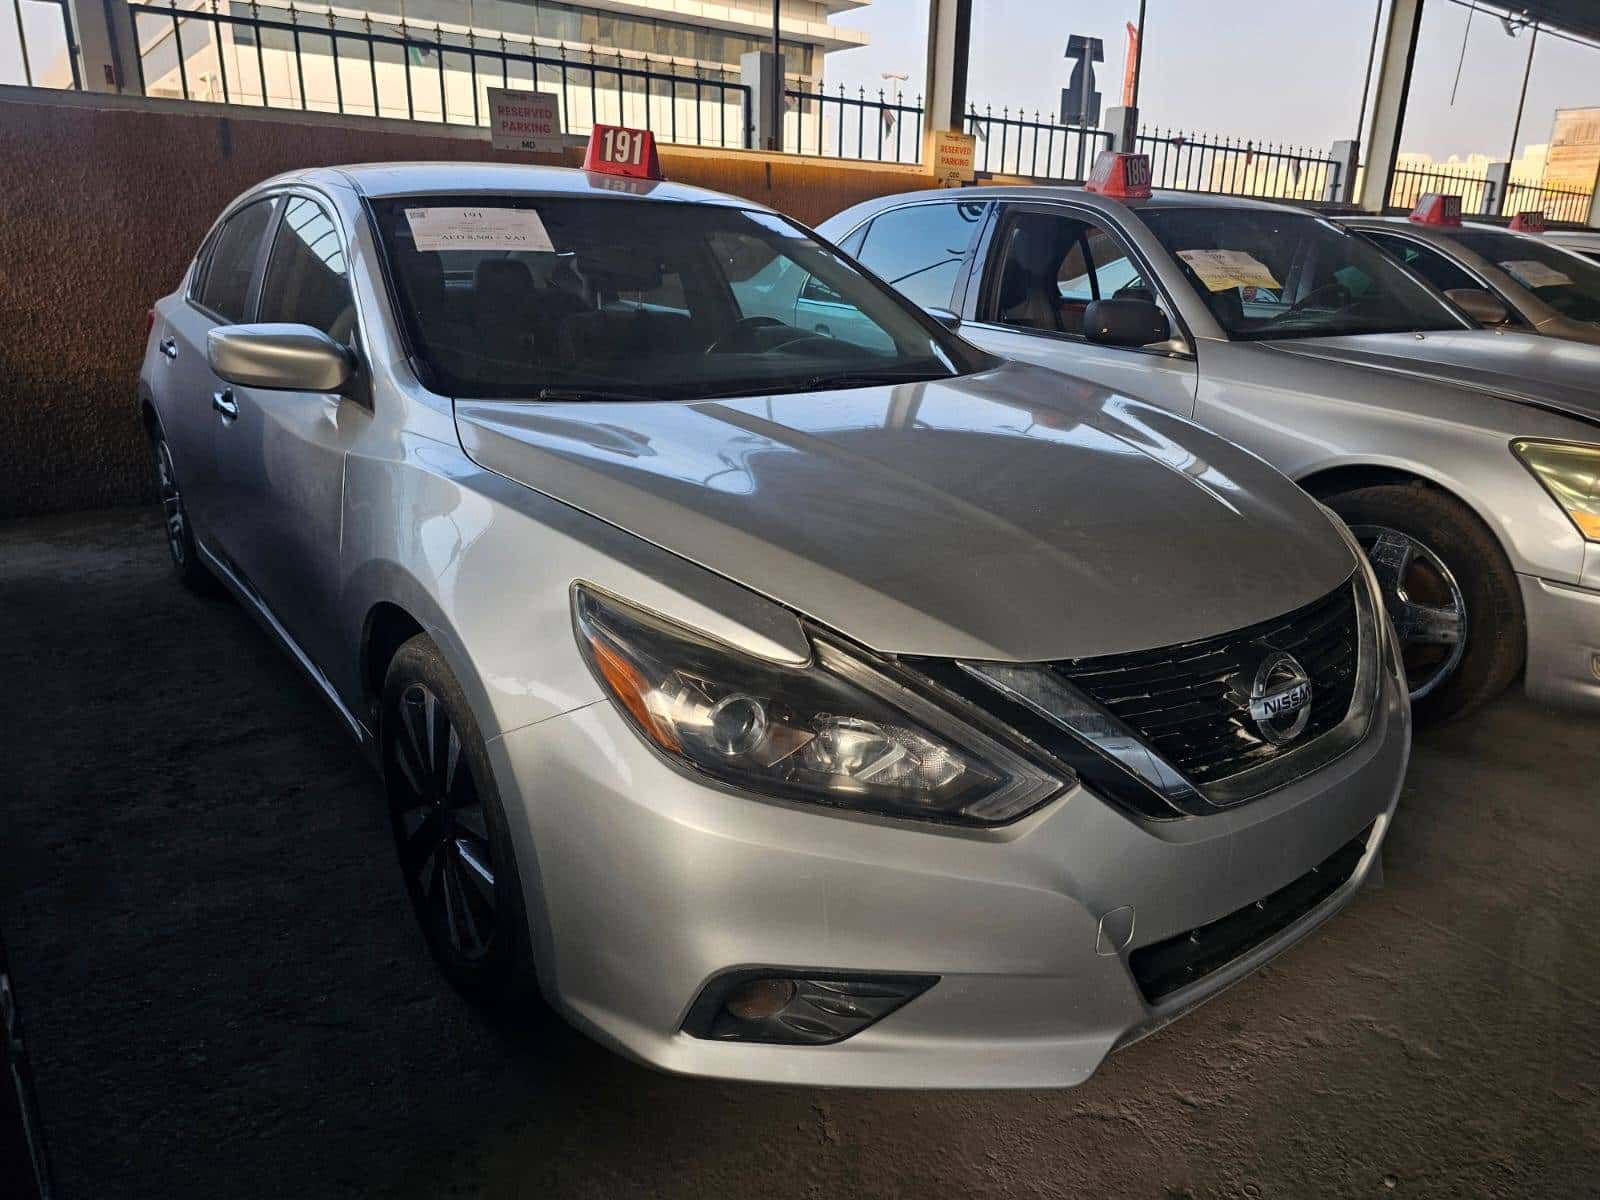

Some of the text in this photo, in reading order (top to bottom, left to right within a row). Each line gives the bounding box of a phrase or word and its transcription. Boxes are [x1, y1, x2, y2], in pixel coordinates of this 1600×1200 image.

[497, 105, 552, 119] RESERVED
[502, 120, 552, 134] PARKING
[521, 140, 536, 149] MD
[604, 129, 642, 165] 191
[940, 145, 972, 155] RESERVED
[941, 157, 969, 167] PARKING
[1127, 158, 1146, 186] 186
[1263, 686, 1311, 714] NISSAN
